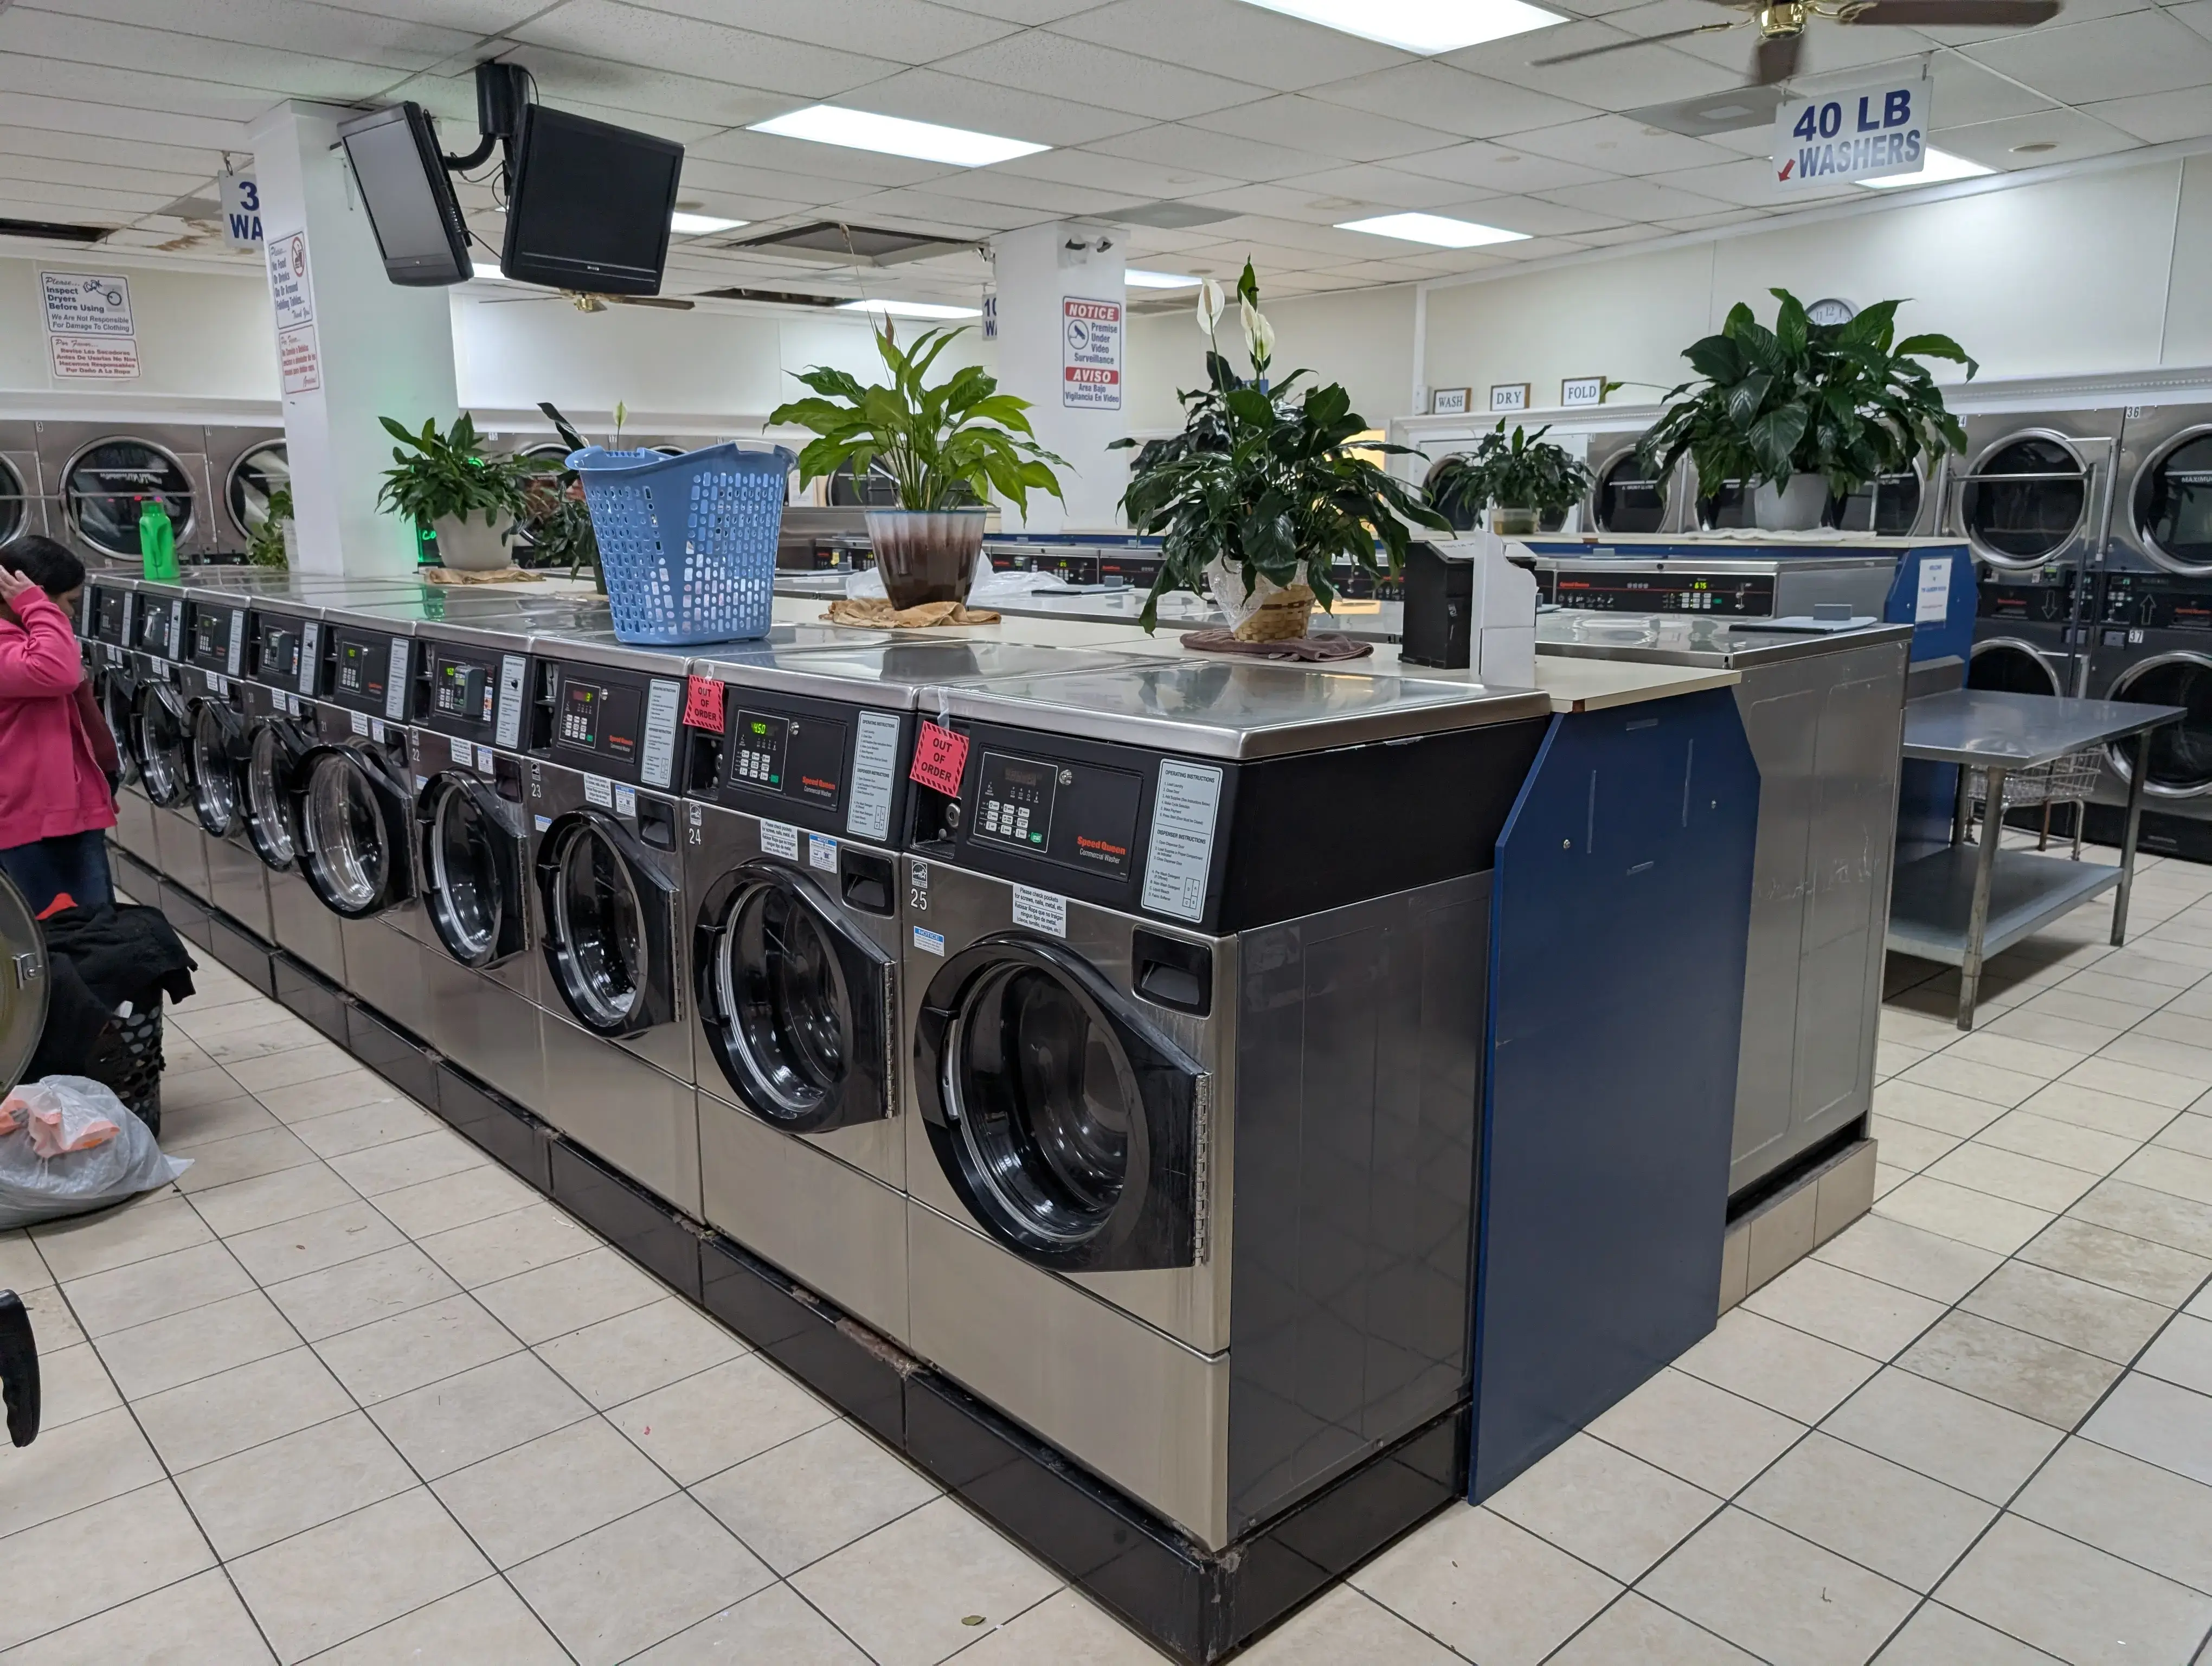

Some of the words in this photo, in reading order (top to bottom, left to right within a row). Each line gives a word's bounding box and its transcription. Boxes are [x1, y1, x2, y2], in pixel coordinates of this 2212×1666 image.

[1793, 102, 1841, 142] 40
[1857, 90, 1911, 132] LB
[1799, 130, 1920, 178] WASHERS
[47, 286, 78, 294] Inspect
[80, 304, 104, 313] Using
[1069, 304, 1115, 319] NOTICE
[66, 322, 92, 330] Damage
[1091, 323, 1117, 333] Premise
[1091, 334, 1109, 343] Under
[1091, 344, 1109, 354] Video
[1075, 353, 1114, 364] Surveillance
[1073, 369, 1110, 382] AVISO
[1094, 385, 1105, 393] Bajo
[1568, 386, 1596, 400] FOLD
[1065, 392, 1092, 401] Vigilancia
[1095, 393, 1102, 401] En
[1439, 395, 1463, 408] WASH
[1496, 392, 1521, 405] DRY
[2127, 407, 2139, 418] 36
[2130, 632, 2142, 642] 37
[698, 687, 711, 697] OUT
[700, 699, 709, 707] OF
[695, 708, 716, 721] ORDER
[933, 738, 952, 752] OUT
[413, 748, 420, 761] 22
[933, 753, 946, 764] OF
[921, 761, 952, 782] ORDER
[802, 776, 819, 785] Speed
[819, 780, 835, 790] Queen
[1187, 773, 1214, 783] INSTRUCTIONS
[532, 783, 541, 798] 23
[689, 828, 701, 845] 24
[1157, 830, 1178, 838] DISPENSER
[1179, 833, 1206, 844] INSTRUCTIONS
[1077, 836, 1101, 849] Speed
[1101, 841, 1126, 855] Queen
[1080, 848, 1103, 860] Commercial
[1104, 854, 1120, 863] Washer
[1020, 887, 1032, 895] Please
[911, 888, 927, 911] 25
[1021, 896, 1034, 904] screws,
[918, 929, 939, 940] NOTICE
